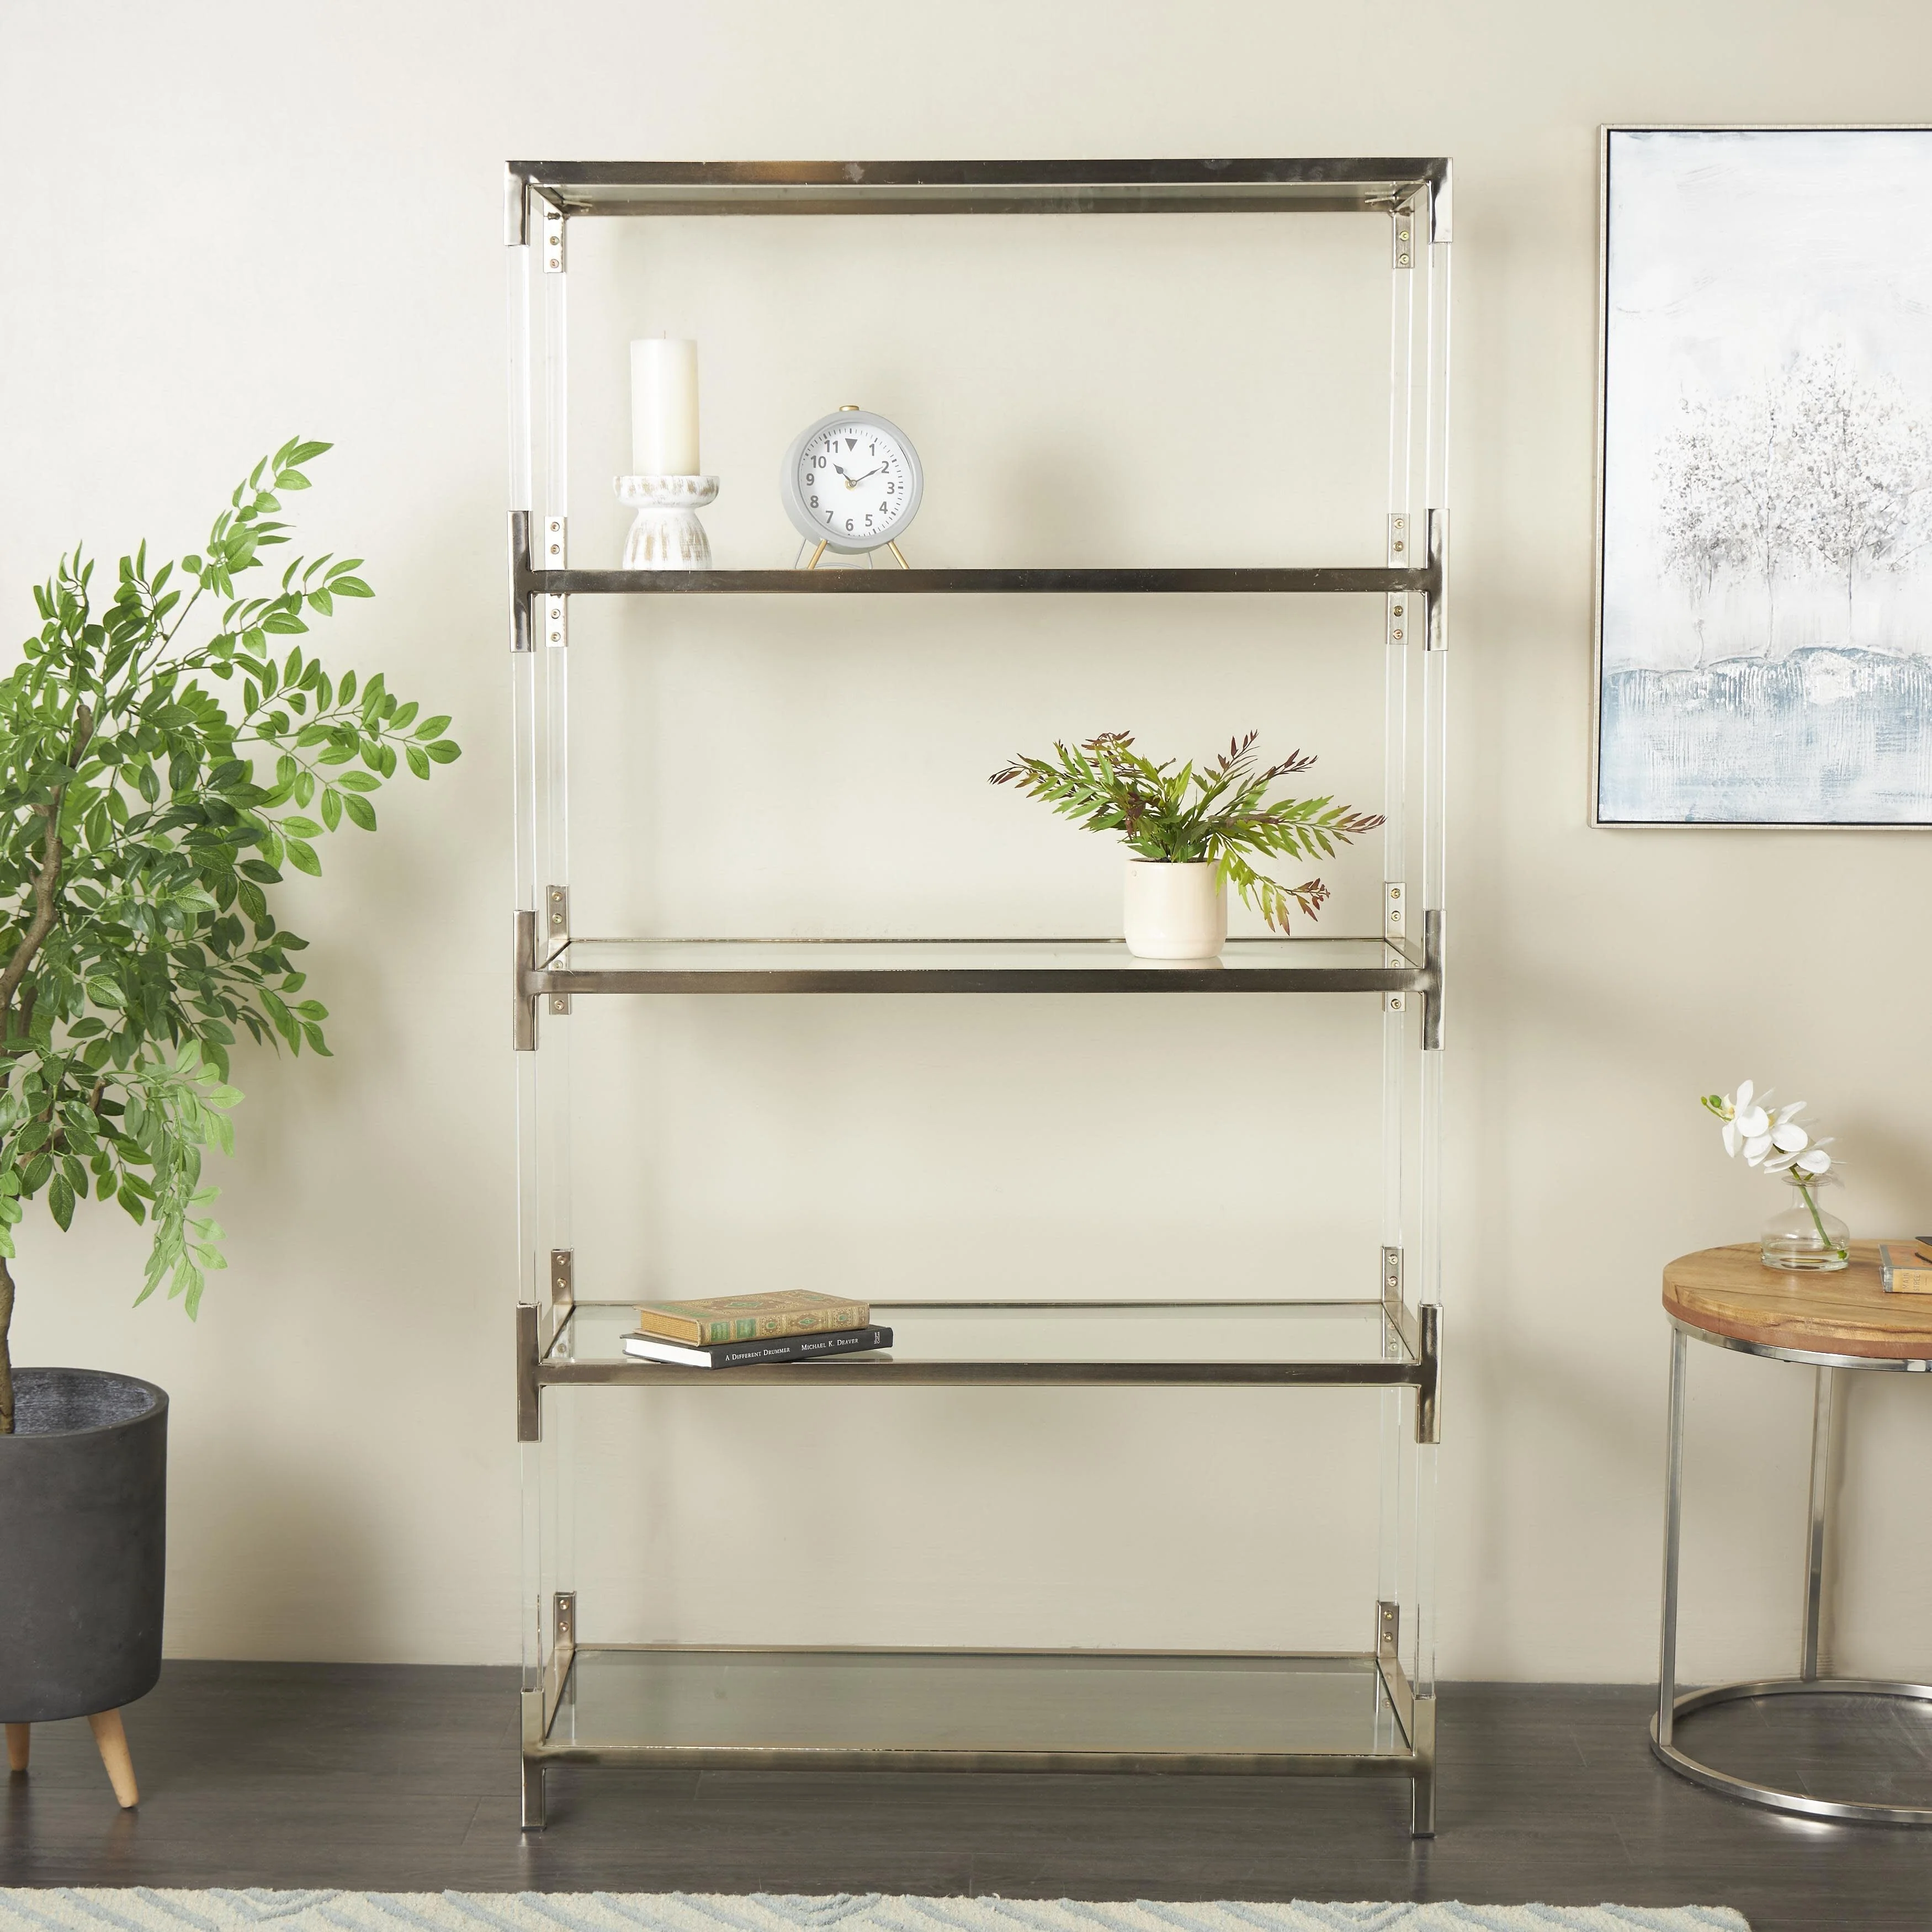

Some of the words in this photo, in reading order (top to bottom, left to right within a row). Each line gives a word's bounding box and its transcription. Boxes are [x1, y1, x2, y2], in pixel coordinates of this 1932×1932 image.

[824, 440, 838, 453] 11
[869, 443, 875, 456] 1
[810, 455, 827, 469] 10
[880, 460, 890, 474] 2
[806, 473, 815, 486] 9
[887, 481, 895, 495] 3
[810, 495, 819, 508] 8
[879, 501, 888, 514] 4
[825, 510, 834, 524] 7
[865, 514, 873, 527] 5
[845, 518, 853, 531] 6
[802, 1342, 826, 1351] MICHAEL
[732, 1351, 762, 1360] DIFFERENT
[763, 1347, 790, 1356] DRUMMER
